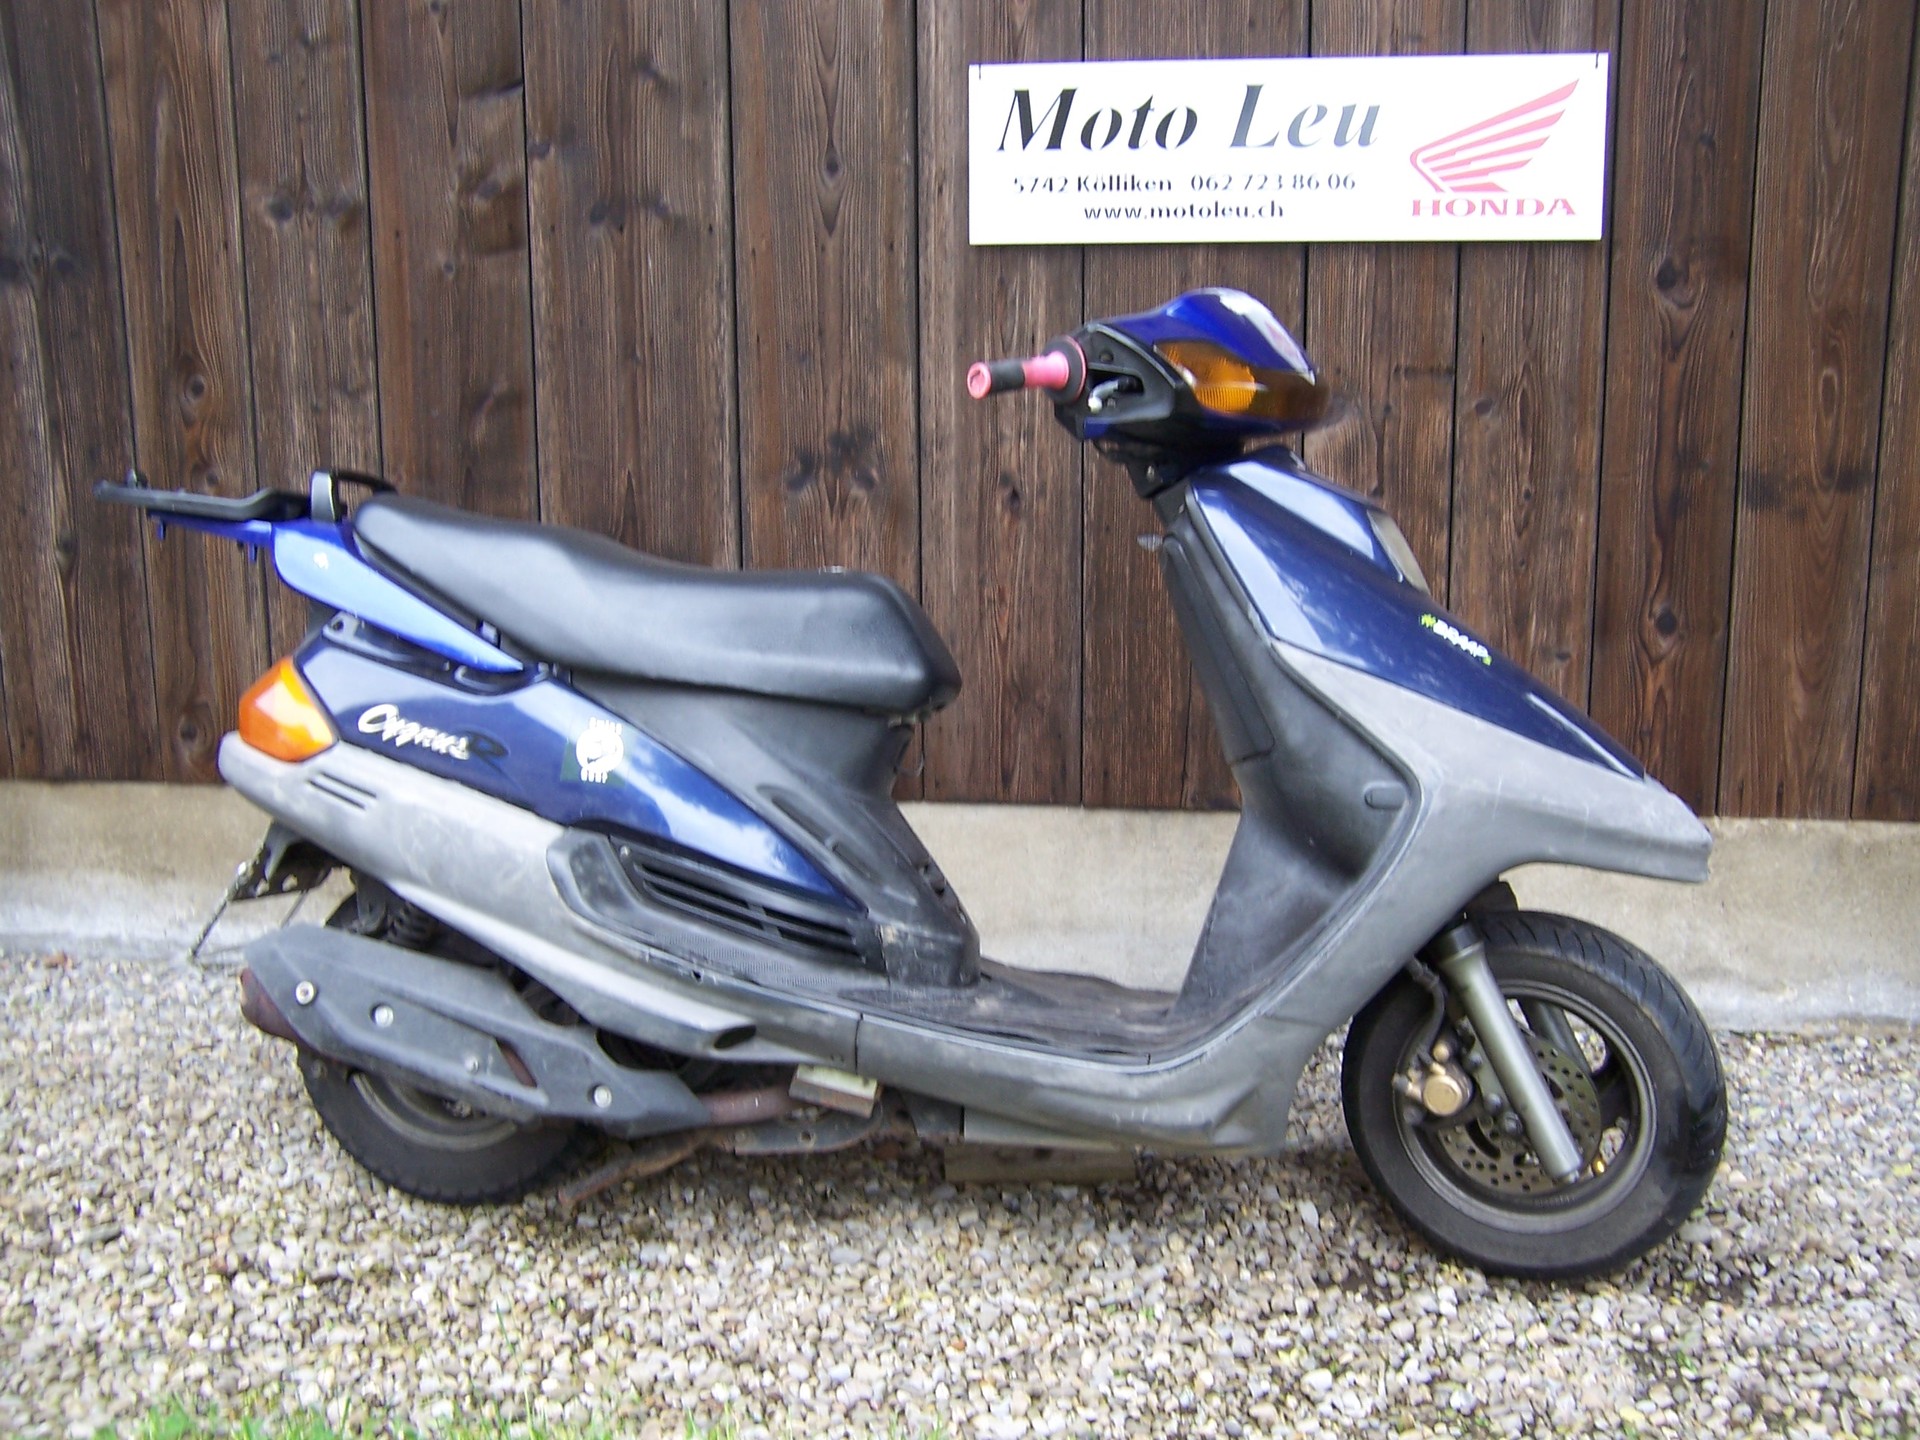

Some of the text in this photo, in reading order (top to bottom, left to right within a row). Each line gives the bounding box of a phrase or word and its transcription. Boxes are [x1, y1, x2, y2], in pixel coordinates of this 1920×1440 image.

[997, 84, 1381, 151] Moto Leu
[1013, 172, 1356, 194] 5742 Kölliken 062 723 86 06
[1084, 200, 1284, 220] www.motoleu.ch
[1411, 198, 1577, 218] HONDA
